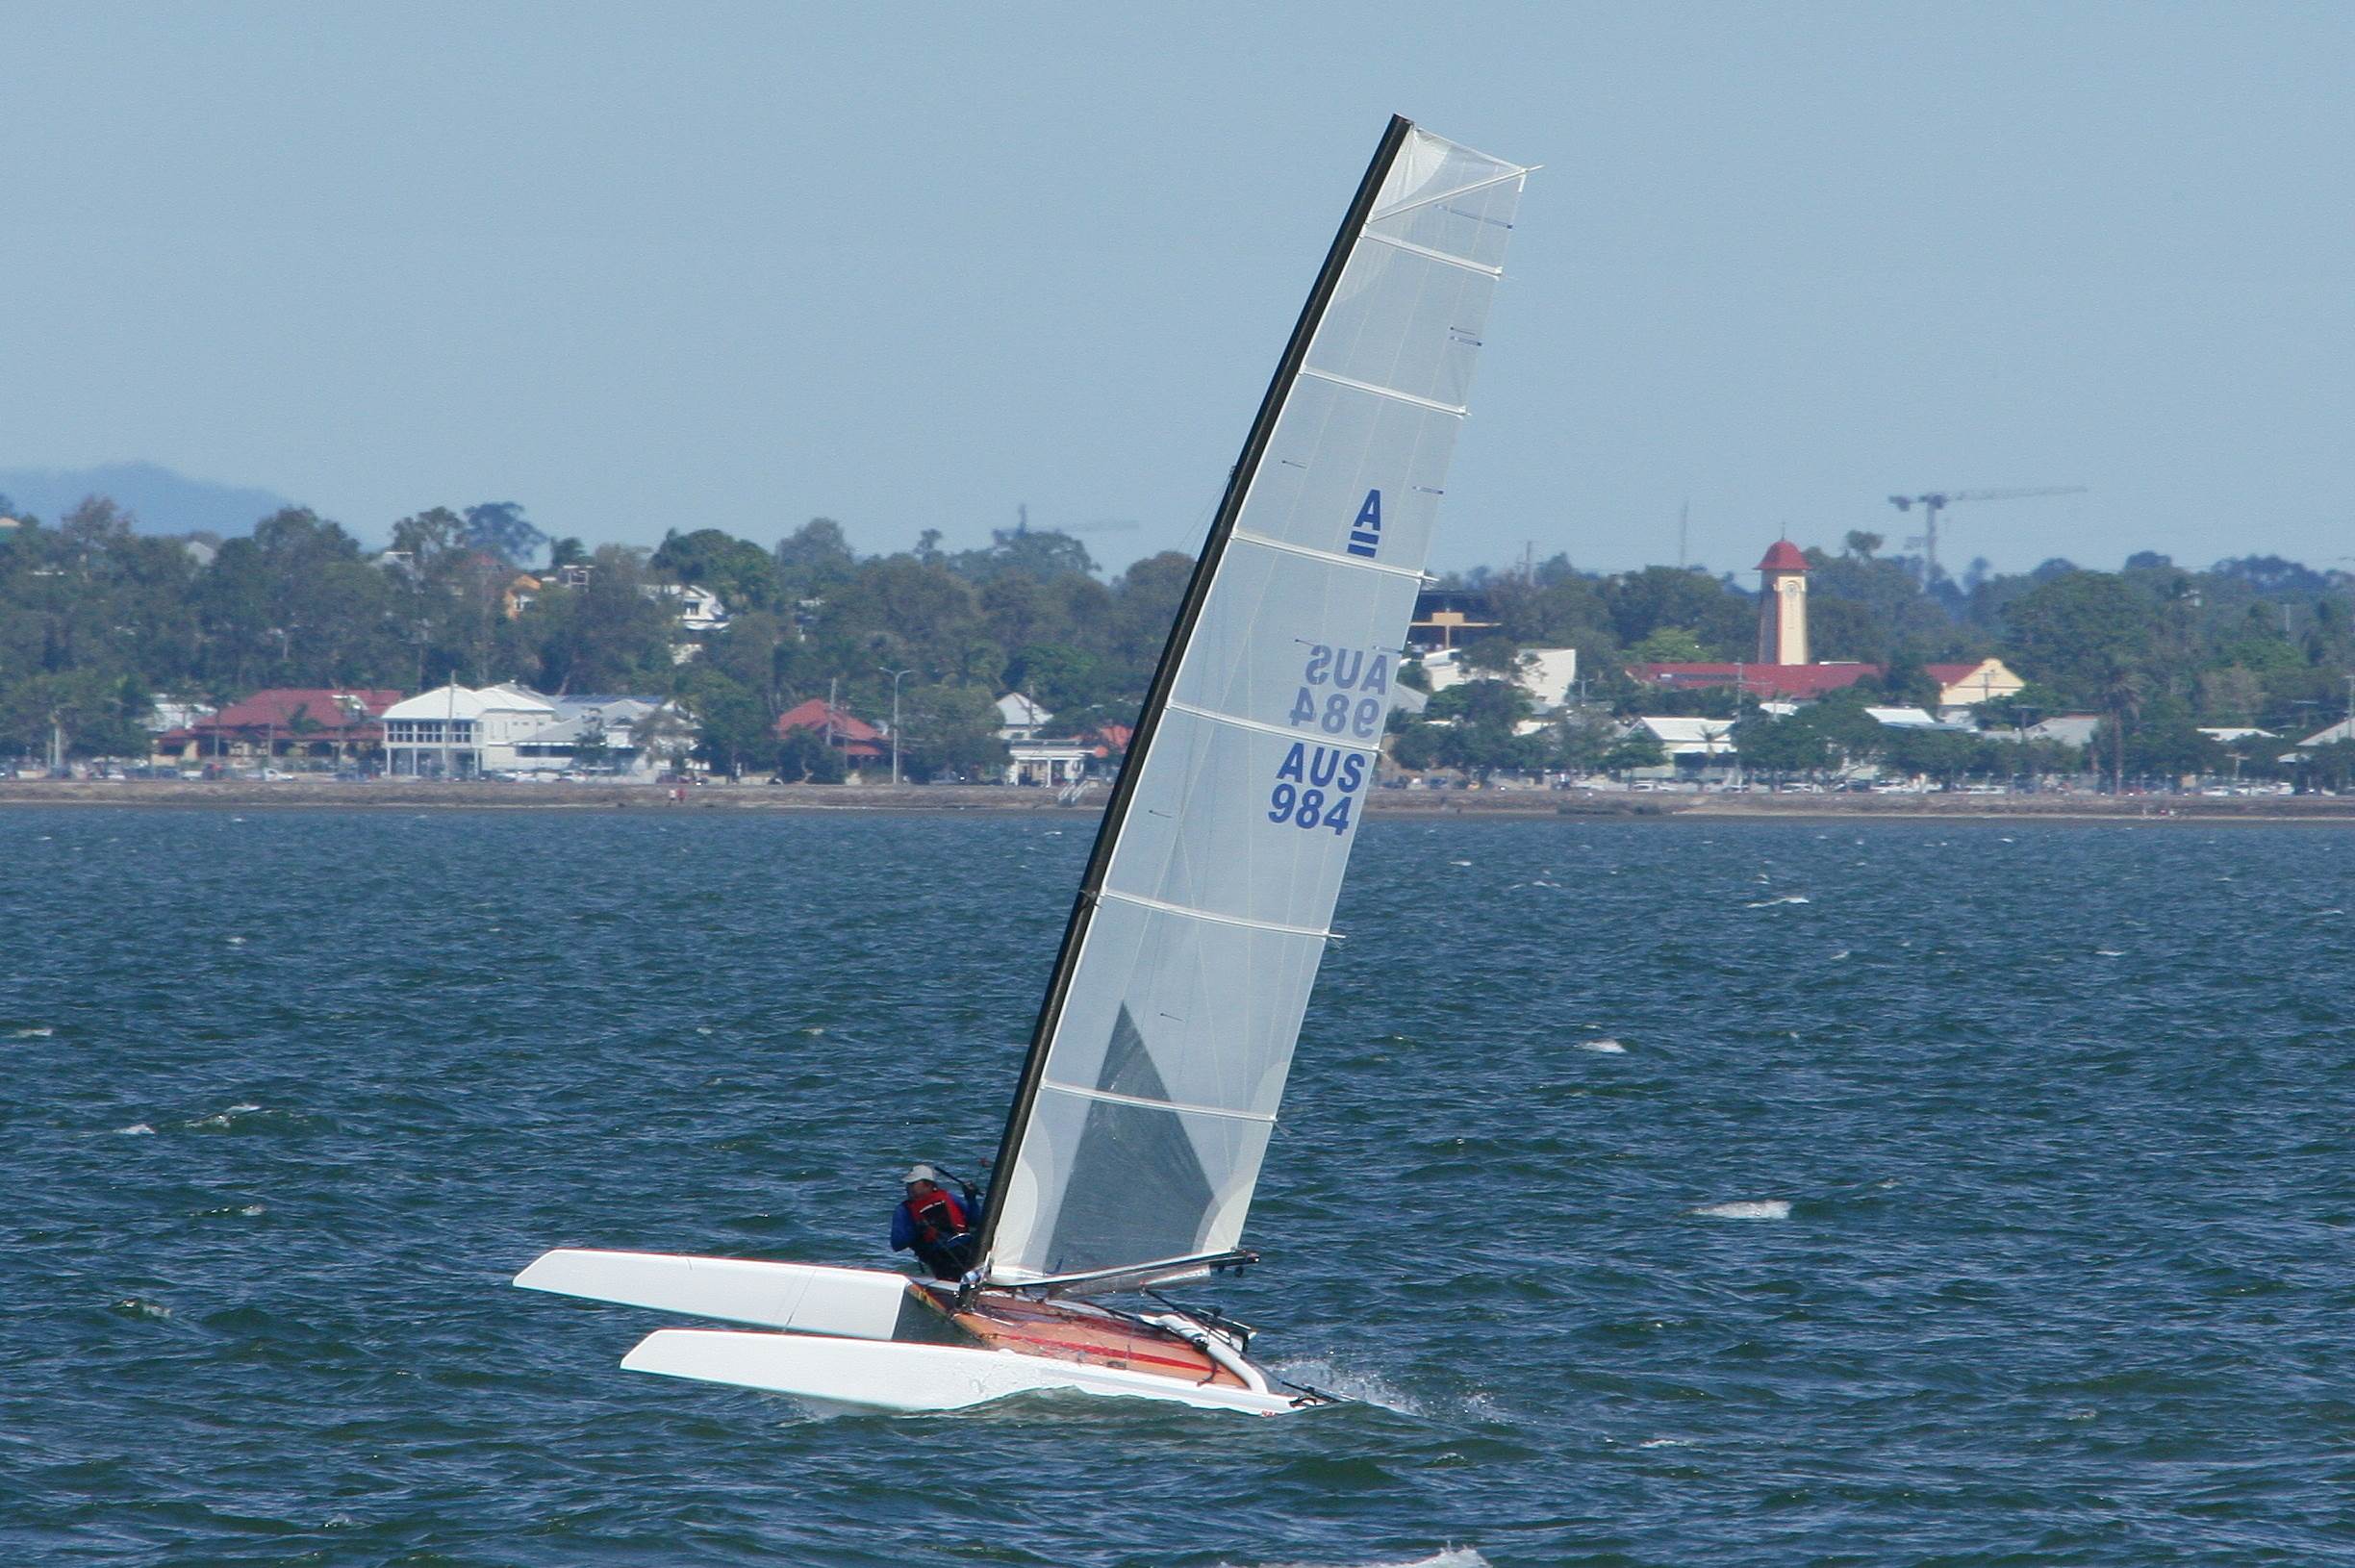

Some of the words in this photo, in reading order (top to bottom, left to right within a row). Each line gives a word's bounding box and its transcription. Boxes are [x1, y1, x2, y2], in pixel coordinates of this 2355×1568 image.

[1354, 489, 1381, 531] A
[1276, 742, 1366, 794] AUS
[1268, 783, 1353, 836] 984
